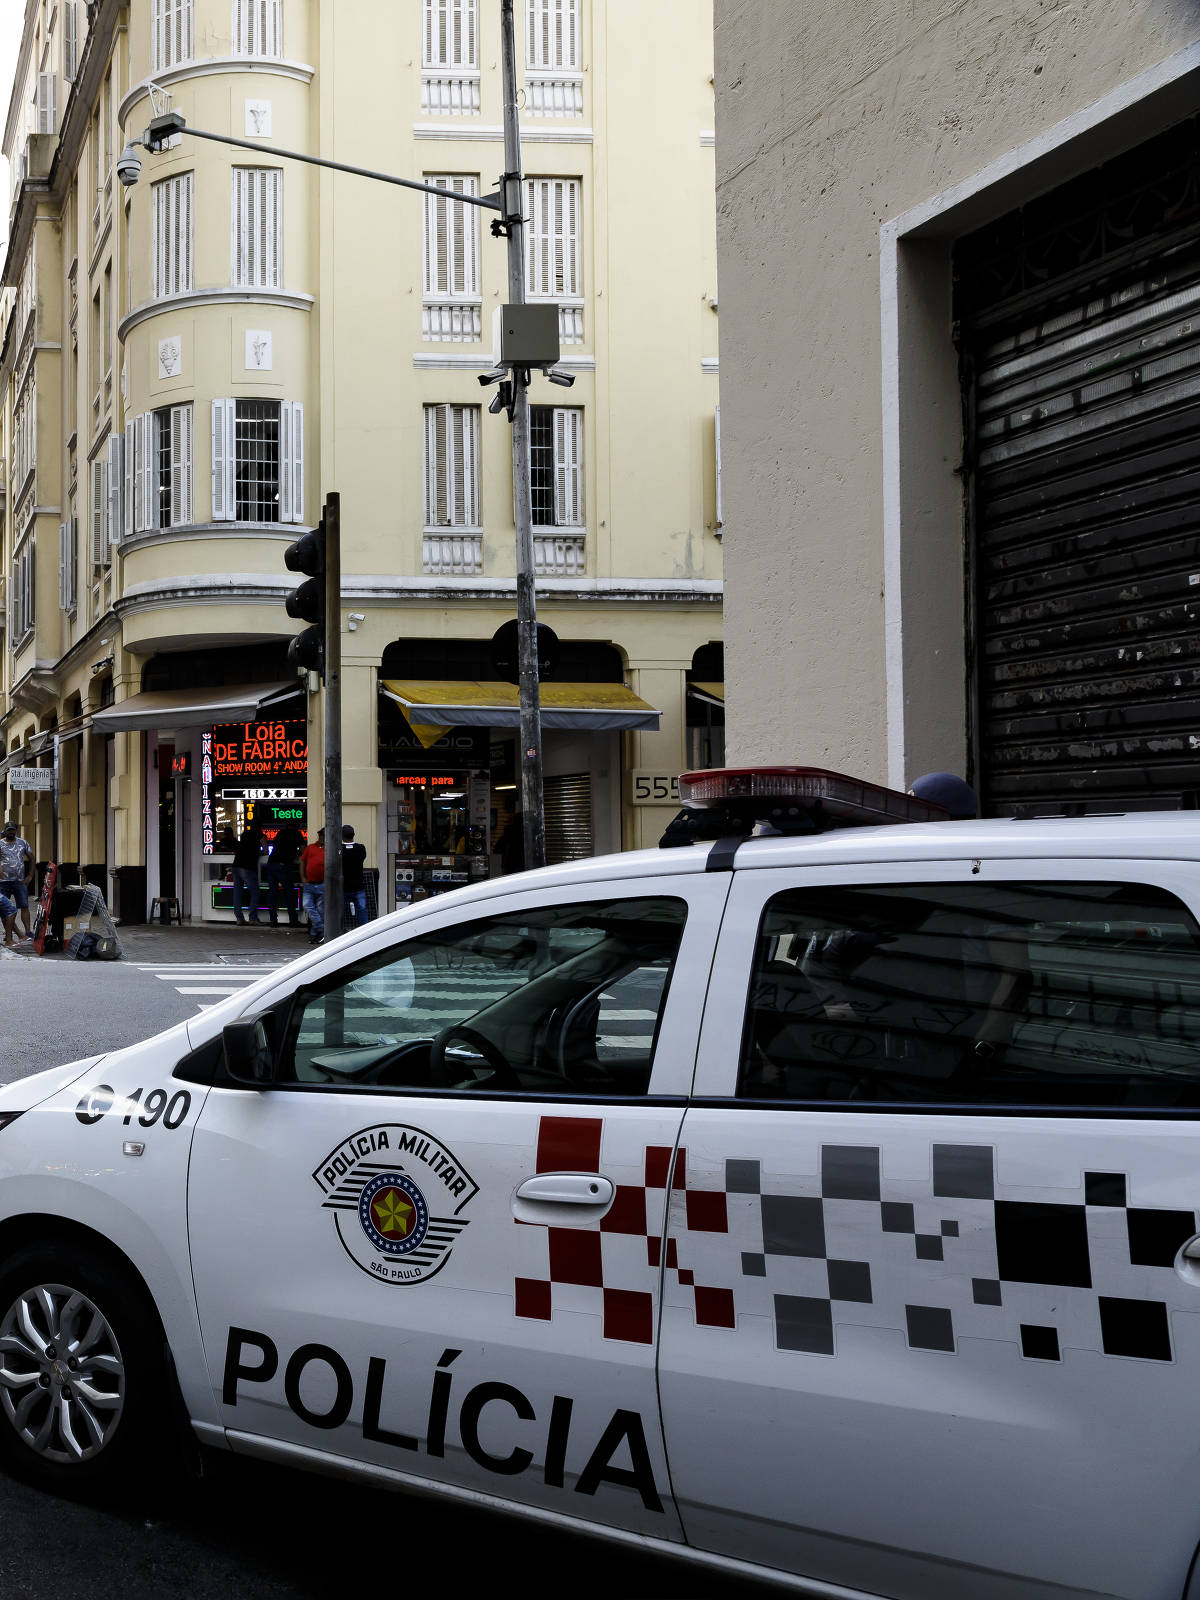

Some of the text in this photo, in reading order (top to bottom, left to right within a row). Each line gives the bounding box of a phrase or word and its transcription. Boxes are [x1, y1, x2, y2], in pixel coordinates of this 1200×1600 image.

[216, 739, 308, 761] DE FÁBRIC
[11, 769, 50, 779] Sta. Ifigênia
[217, 763, 243, 773] SHOW
[245, 762, 271, 772] ROOM
[396, 776, 454, 786] arcas para
[280, 789, 295, 799] 20
[271, 807, 303, 819] Teste
[122, 1087, 191, 1130] 190
[323, 1131, 467, 1197] POLÍCIA MILITAR
[369, 1261, 422, 1280] SÃO PAULO
[222, 1326, 665, 1514] POLÍCIA
